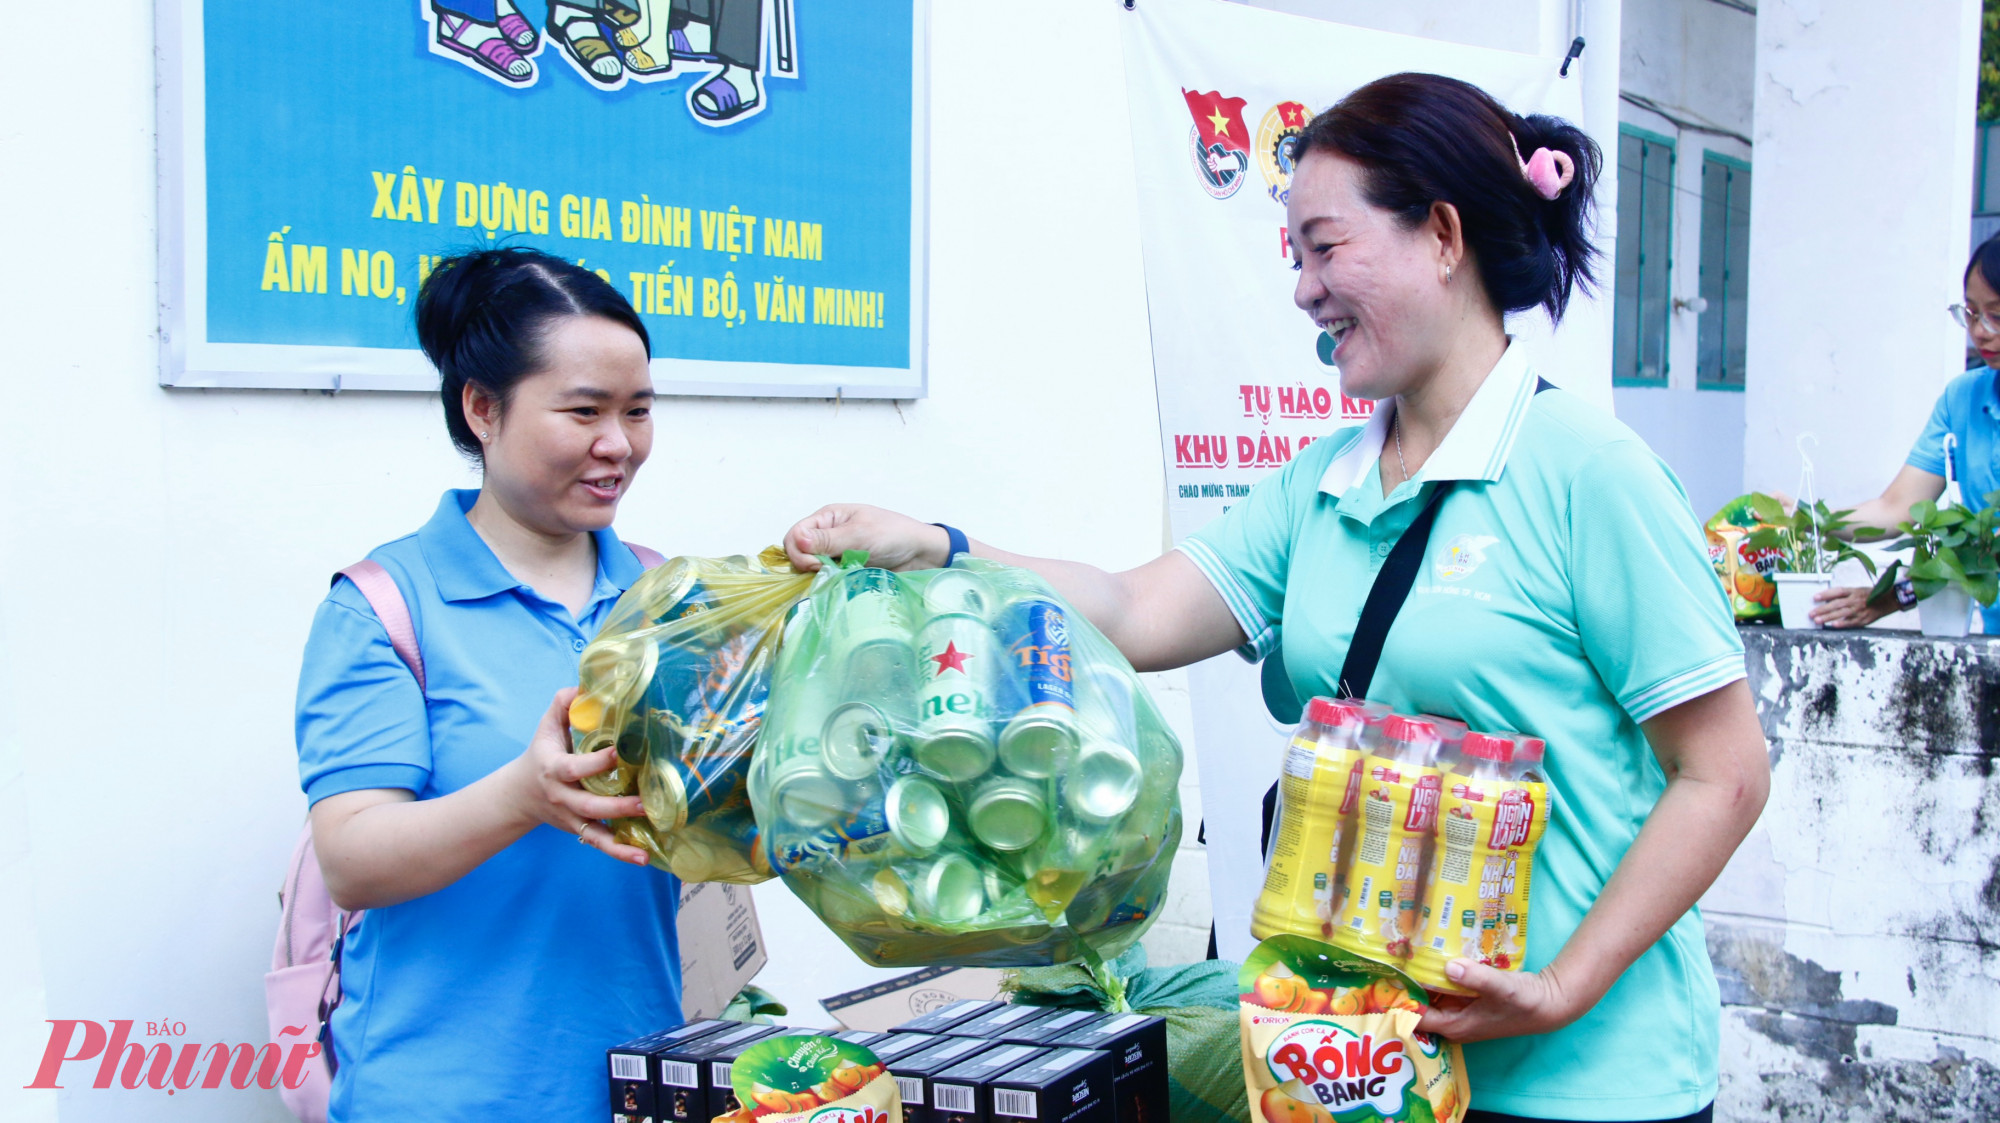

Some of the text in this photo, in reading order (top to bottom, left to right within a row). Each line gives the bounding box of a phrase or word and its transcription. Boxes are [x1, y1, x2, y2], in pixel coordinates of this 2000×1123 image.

[371, 165, 823, 262] XÂY DỰNG GIA ĐÌNH VIỆT NAM
[261, 226, 328, 294] ẤM
[341, 248, 406, 306] NO,
[629, 260, 694, 317] TIẾN
[702, 271, 747, 328] BỘ,
[754, 275, 806, 324] VĂN
[813, 286, 884, 329] MINH!
[1239, 382, 1377, 422] TỰ HÀO KH
[1174, 434, 1228, 464] KHU
[1236, 430, 1292, 464] DÂN
[1178, 482, 1200, 499] CHÀO
[1200, 482, 1225, 498] MỪNG
[787, 1040, 817, 1069] Chuyện
[1273, 1029, 1404, 1086] BỐNG
[1313, 1076, 1387, 1106] BANG
